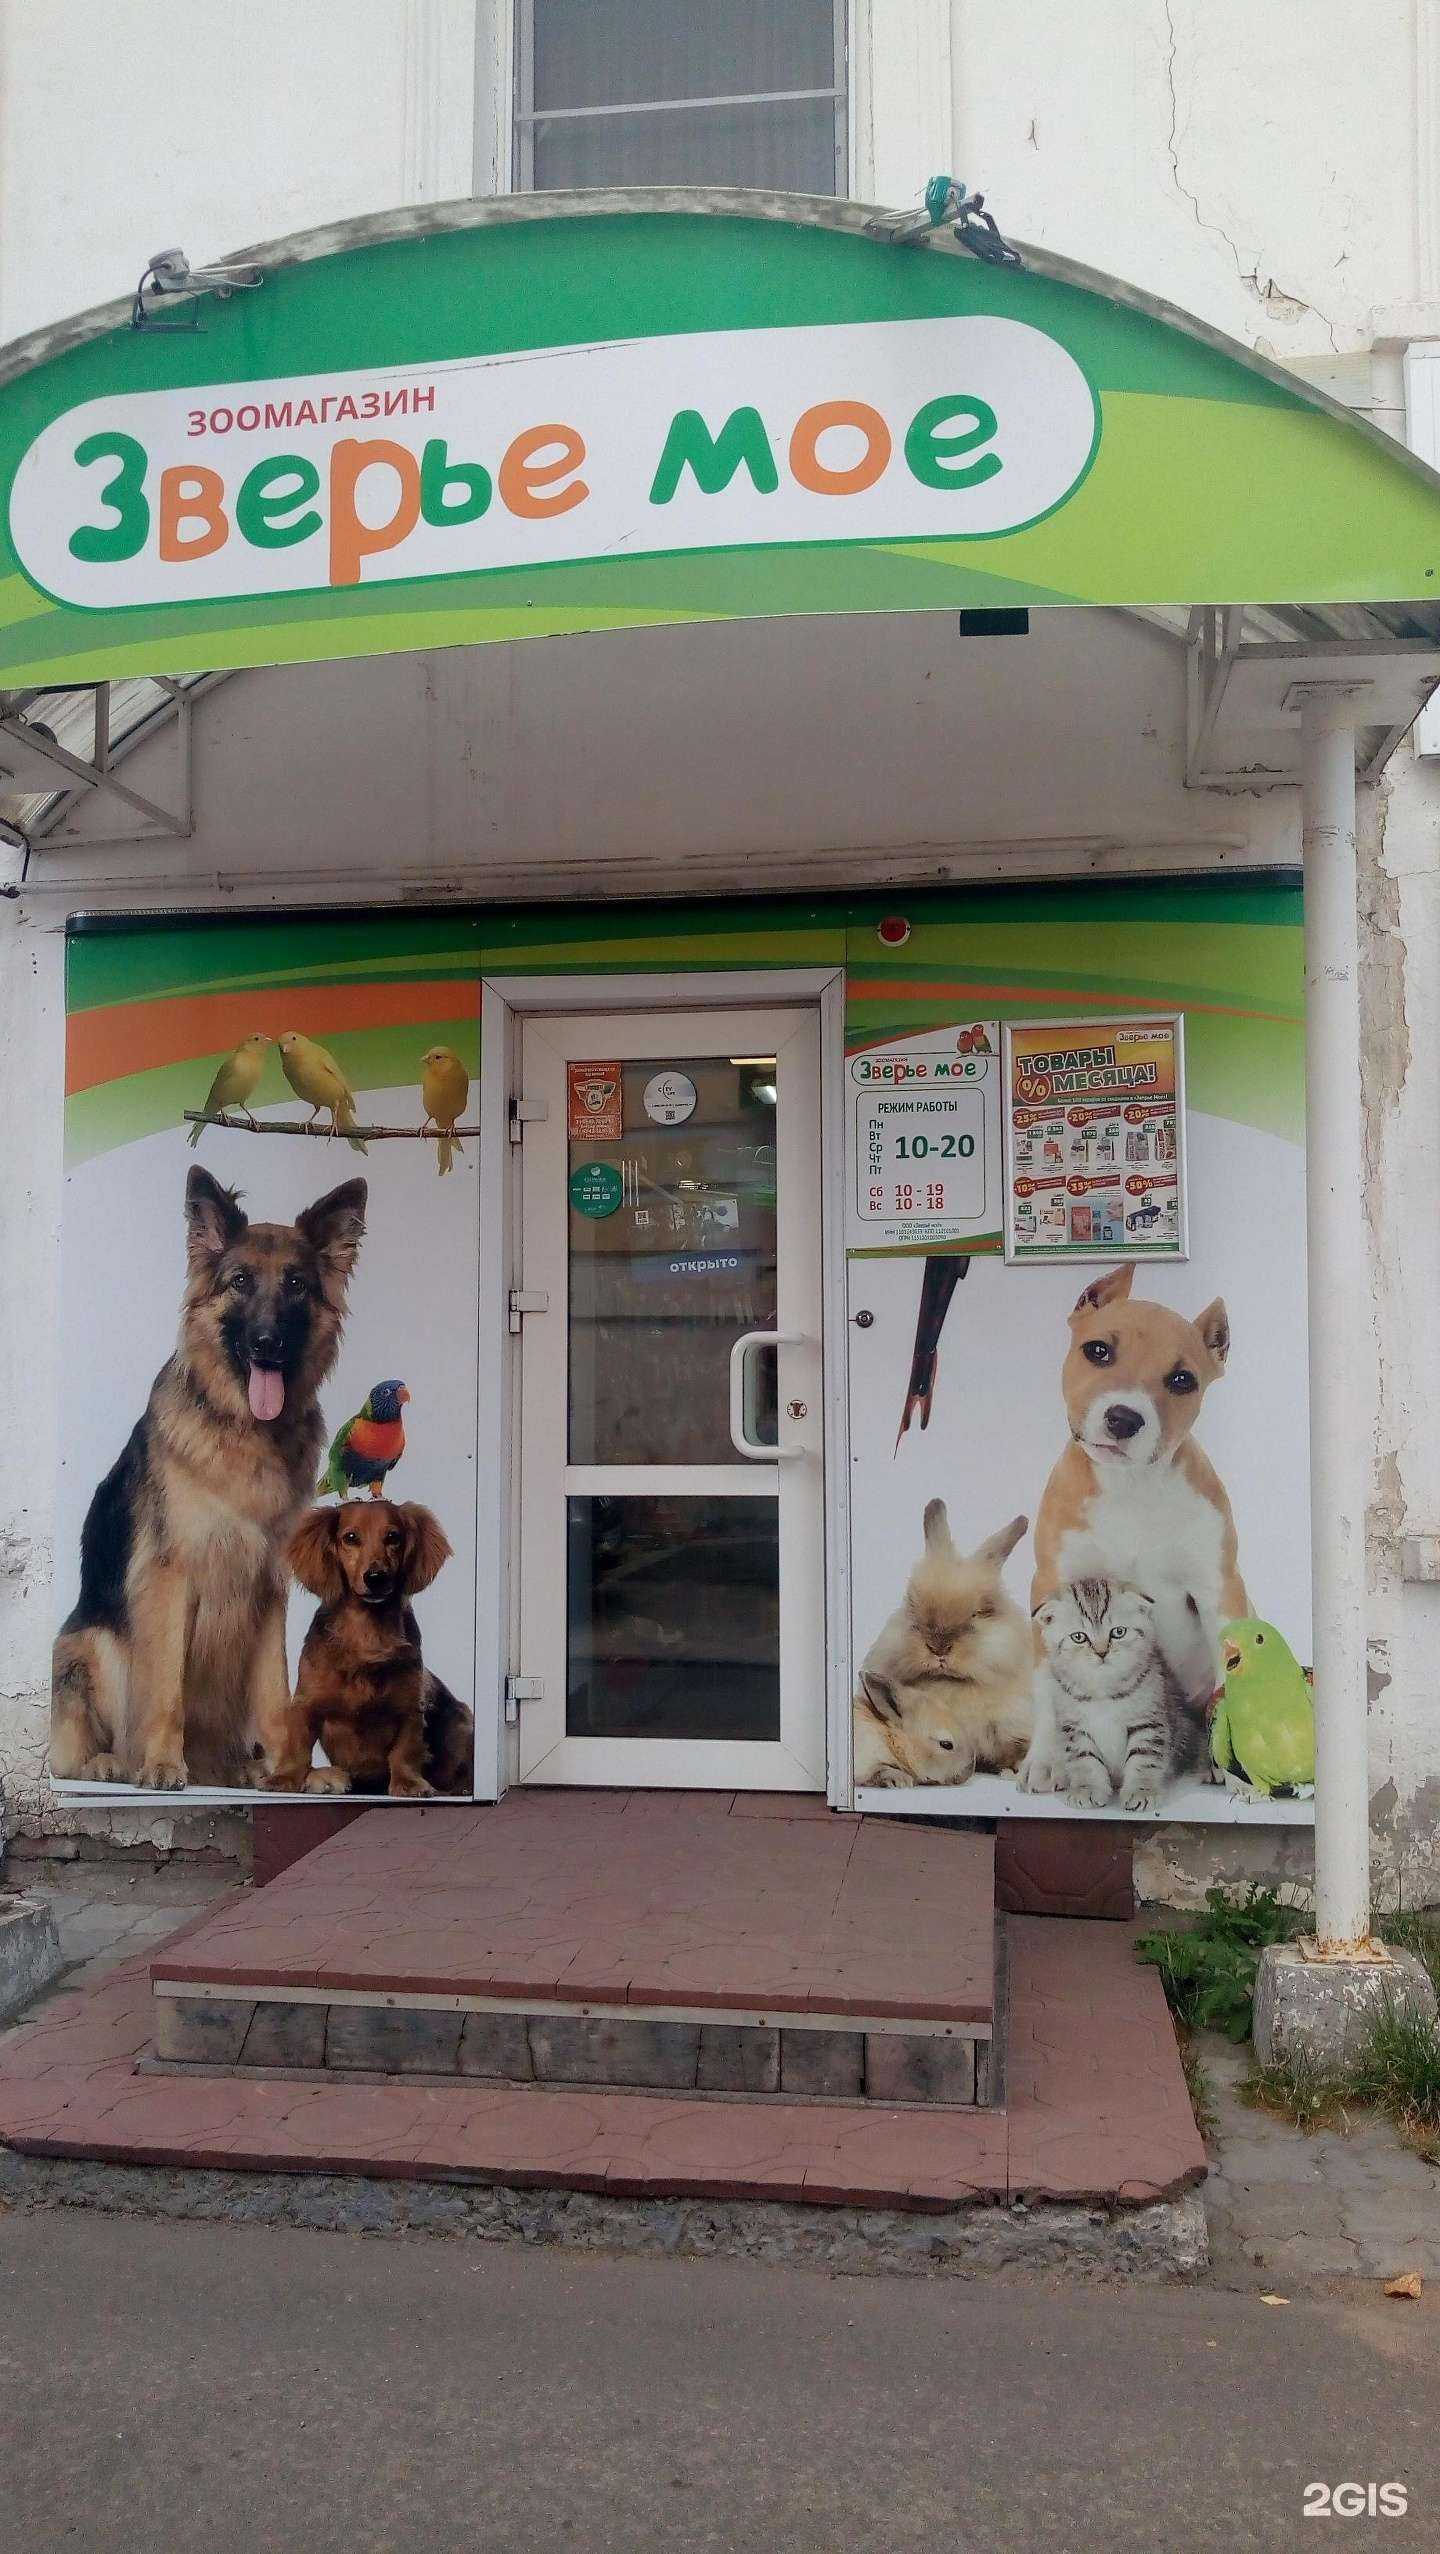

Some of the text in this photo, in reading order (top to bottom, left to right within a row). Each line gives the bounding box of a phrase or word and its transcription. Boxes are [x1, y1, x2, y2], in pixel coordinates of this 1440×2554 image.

[187, 386, 436, 436] ЗООМАГАЗИН
[69, 394, 1003, 587] Зверье мое
[1018, 1046, 1115, 1076] ТОВАРЫ
[860, 1060, 976, 1085] Зверье мое
[1053, 1063, 1157, 1094] МЕСЯЦА!
[878, 1101, 958, 1114] РЕЖИМ РАБОТЫ
[869, 1119, 884, 1129] Пн
[869, 1131, 881, 1141] Вт
[869, 1142, 883, 1154] Ср
[895, 1134, 975, 1159] 10-20
[869, 1154, 881, 1164] Чт
[869, 1165, 882, 1175] Пт
[869, 1186, 883, 1197] Сб
[895, 1184, 913, 1197] 10
[926, 1183, 944, 1196] 19
[1125, 1179, 1153, 1190] -50%
[869, 1200, 882, 1211] Вс
[895, 1198, 913, 1210] 10
[926, 1197, 944, 1210] 18
[669, 1257, 738, 1273] открыто
